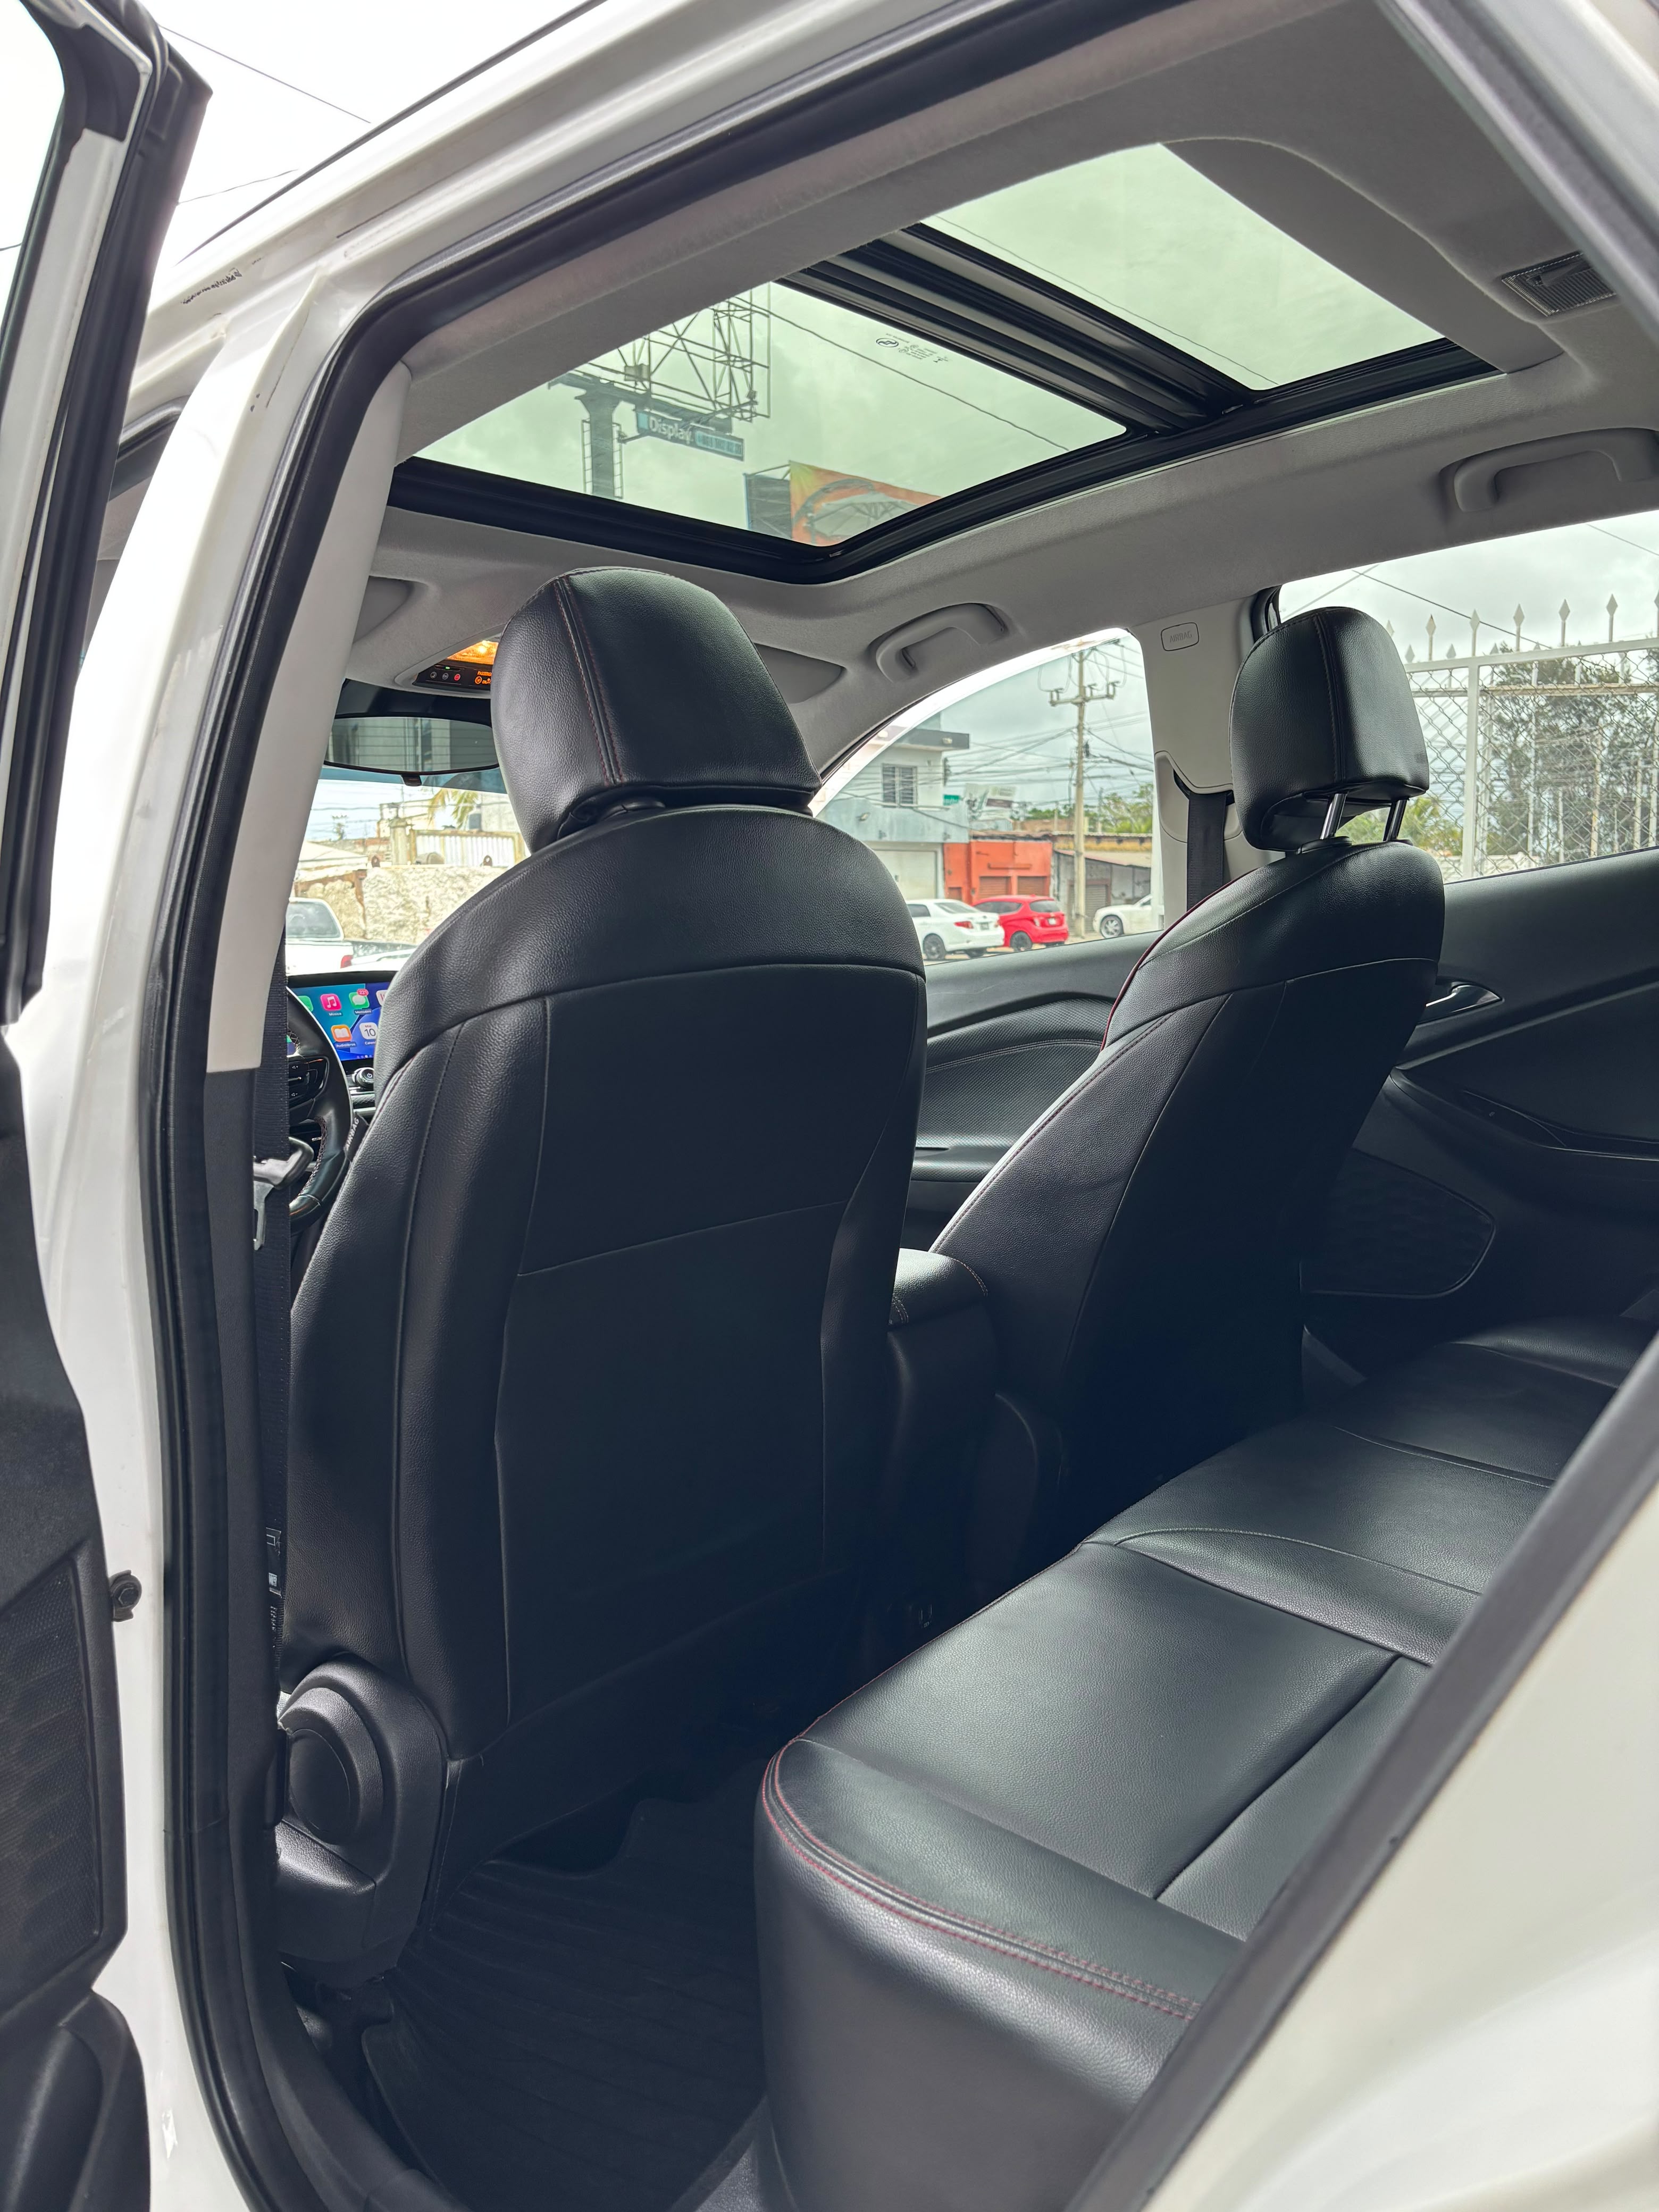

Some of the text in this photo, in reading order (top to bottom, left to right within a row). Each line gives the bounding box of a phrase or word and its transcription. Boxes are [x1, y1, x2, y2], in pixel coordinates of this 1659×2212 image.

[1169, 631, 1192, 643] AIRBAG
[364, 1028, 376, 1037] 10
[345, 1117, 359, 1151] AIRBAG
